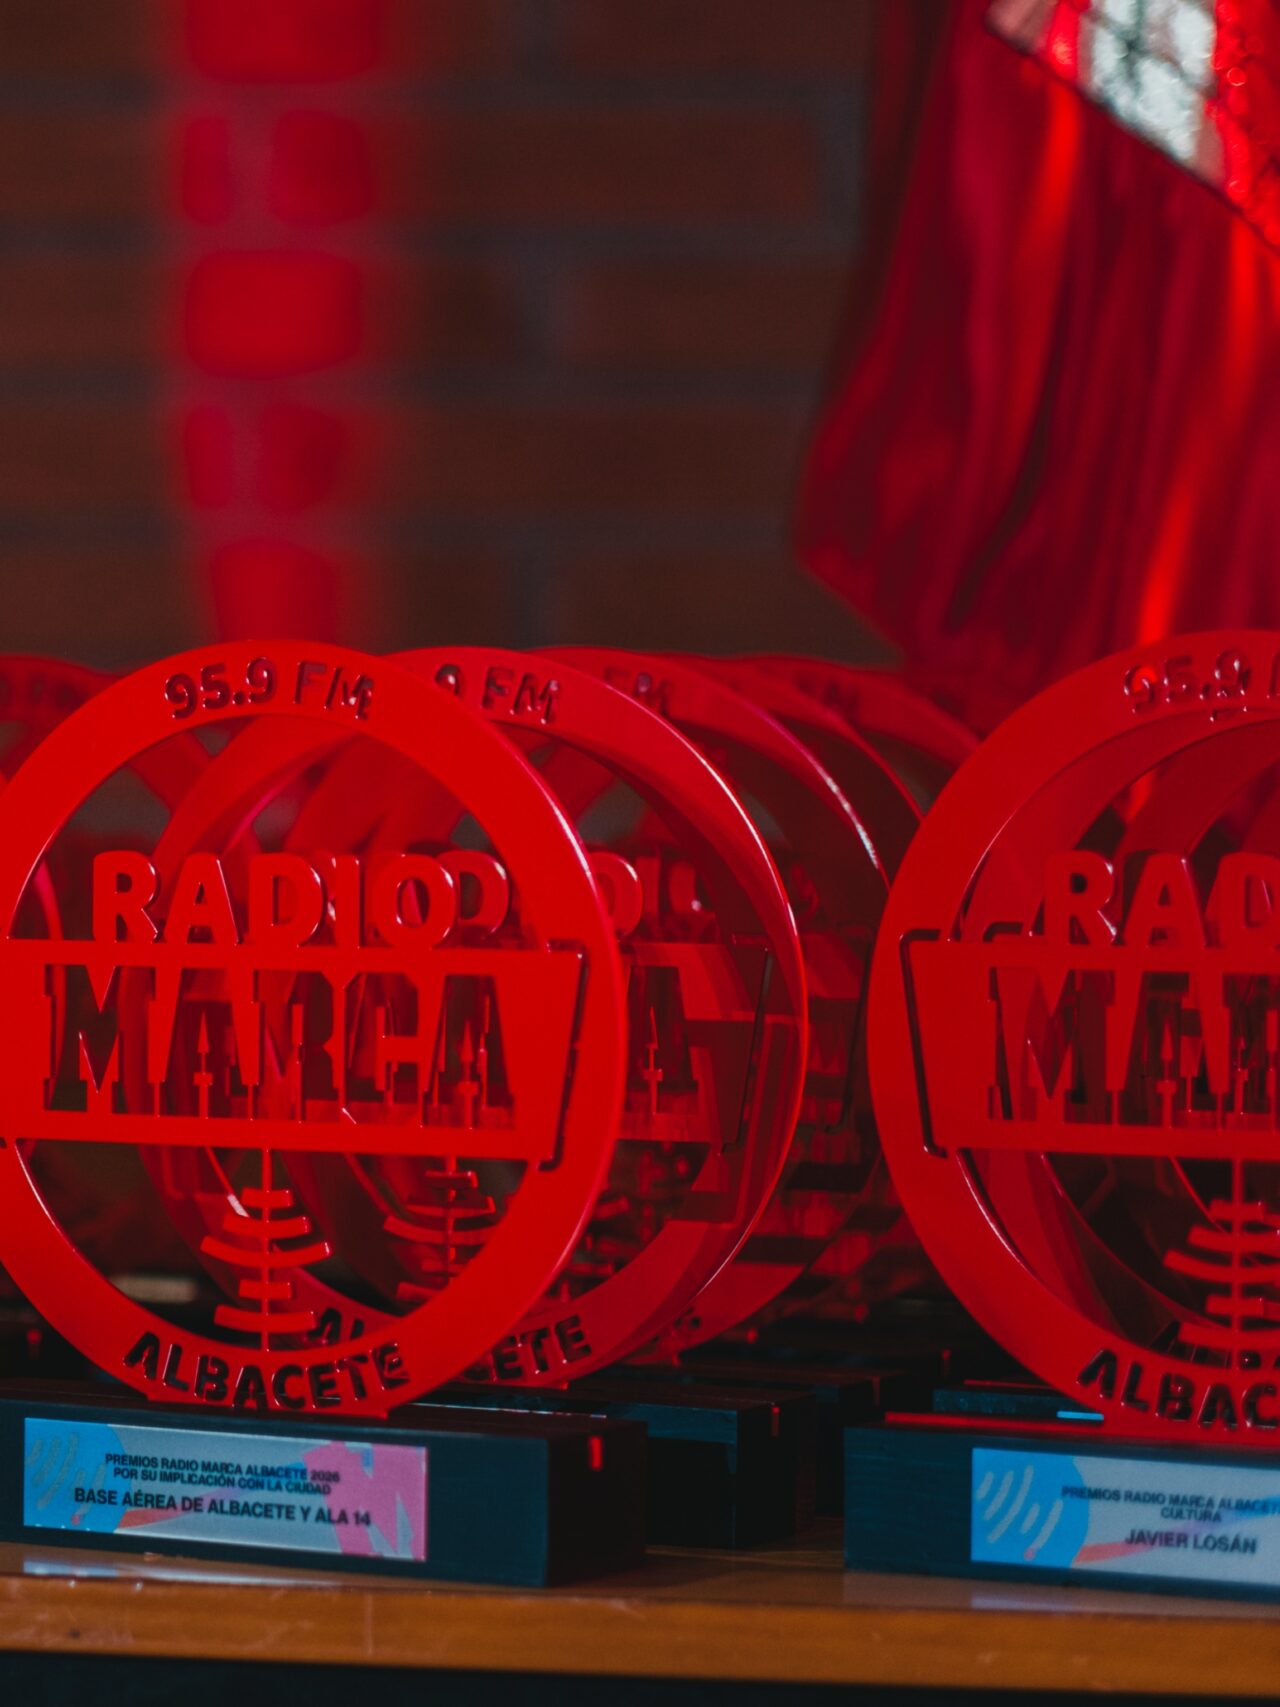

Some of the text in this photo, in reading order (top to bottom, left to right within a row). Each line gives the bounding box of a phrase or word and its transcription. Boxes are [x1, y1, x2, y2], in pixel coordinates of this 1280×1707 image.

[164, 656, 276, 720] 95.9
[292, 660, 375, 720] FM
[481, 664, 560, 725] FM
[1123, 650, 1251, 713] 95.9
[92, 850, 457, 950] RADIO
[42, 963, 518, 1130] MARCA
[122, 1331, 410, 1410] ALBACETE
[105, 1453, 159, 1468] PREMIOS
[161, 1458, 199, 1472] RADIO
[201, 1461, 243, 1475] MARCA
[245, 1464, 308, 1481] ALBACETE
[113, 1467, 332, 1496] POR SU IMPLICACIÓN CON LA CIUDAD
[74, 1487, 371, 1526] BASE AÉREA DE ALBACETE Y ALA 14
[1061, 1486, 1121, 1501] PREMIOS
[1123, 1490, 1166, 1505] RADIO
[1169, 1493, 1215, 1509] MARCA
[1160, 1507, 1222, 1523] CULTURA
[1124, 1529, 1258, 1554] JAVIER LOSÁN
